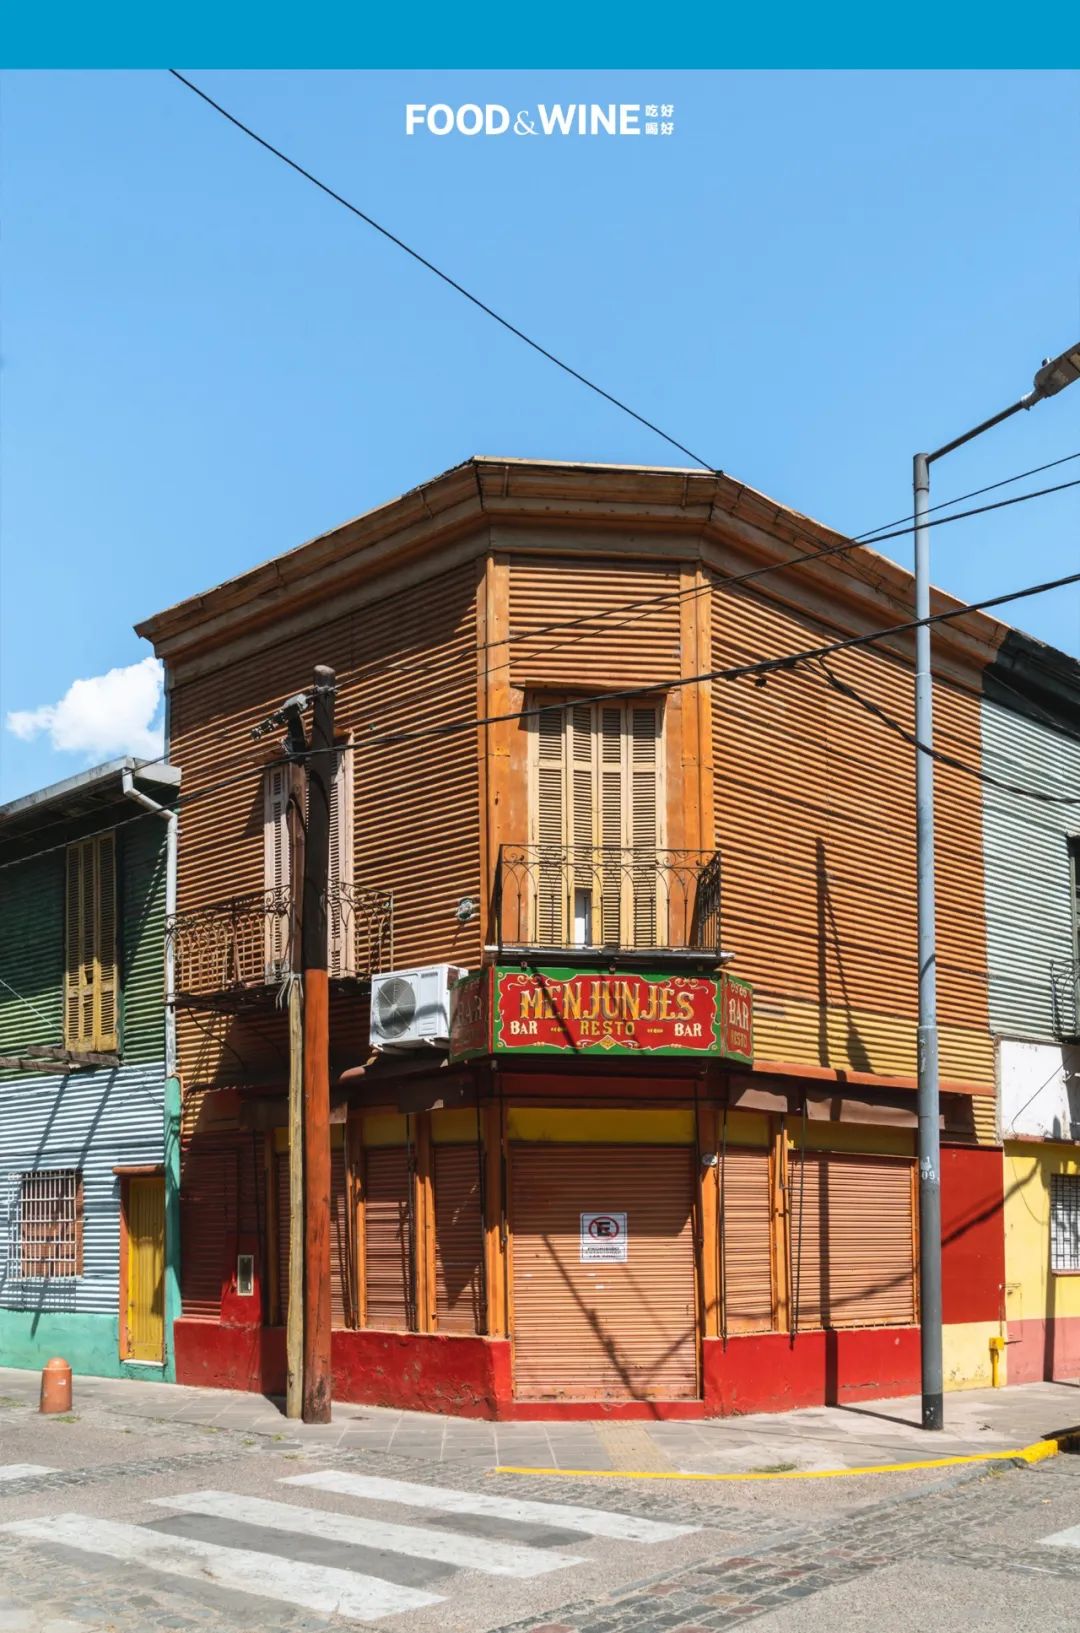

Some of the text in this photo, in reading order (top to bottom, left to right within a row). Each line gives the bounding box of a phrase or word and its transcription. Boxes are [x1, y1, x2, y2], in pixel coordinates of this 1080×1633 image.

[519, 980, 695, 1021] MENJUNJES
[729, 998, 749, 1031] BAR
[510, 1020, 702, 1037] BAR RESTO BAR
